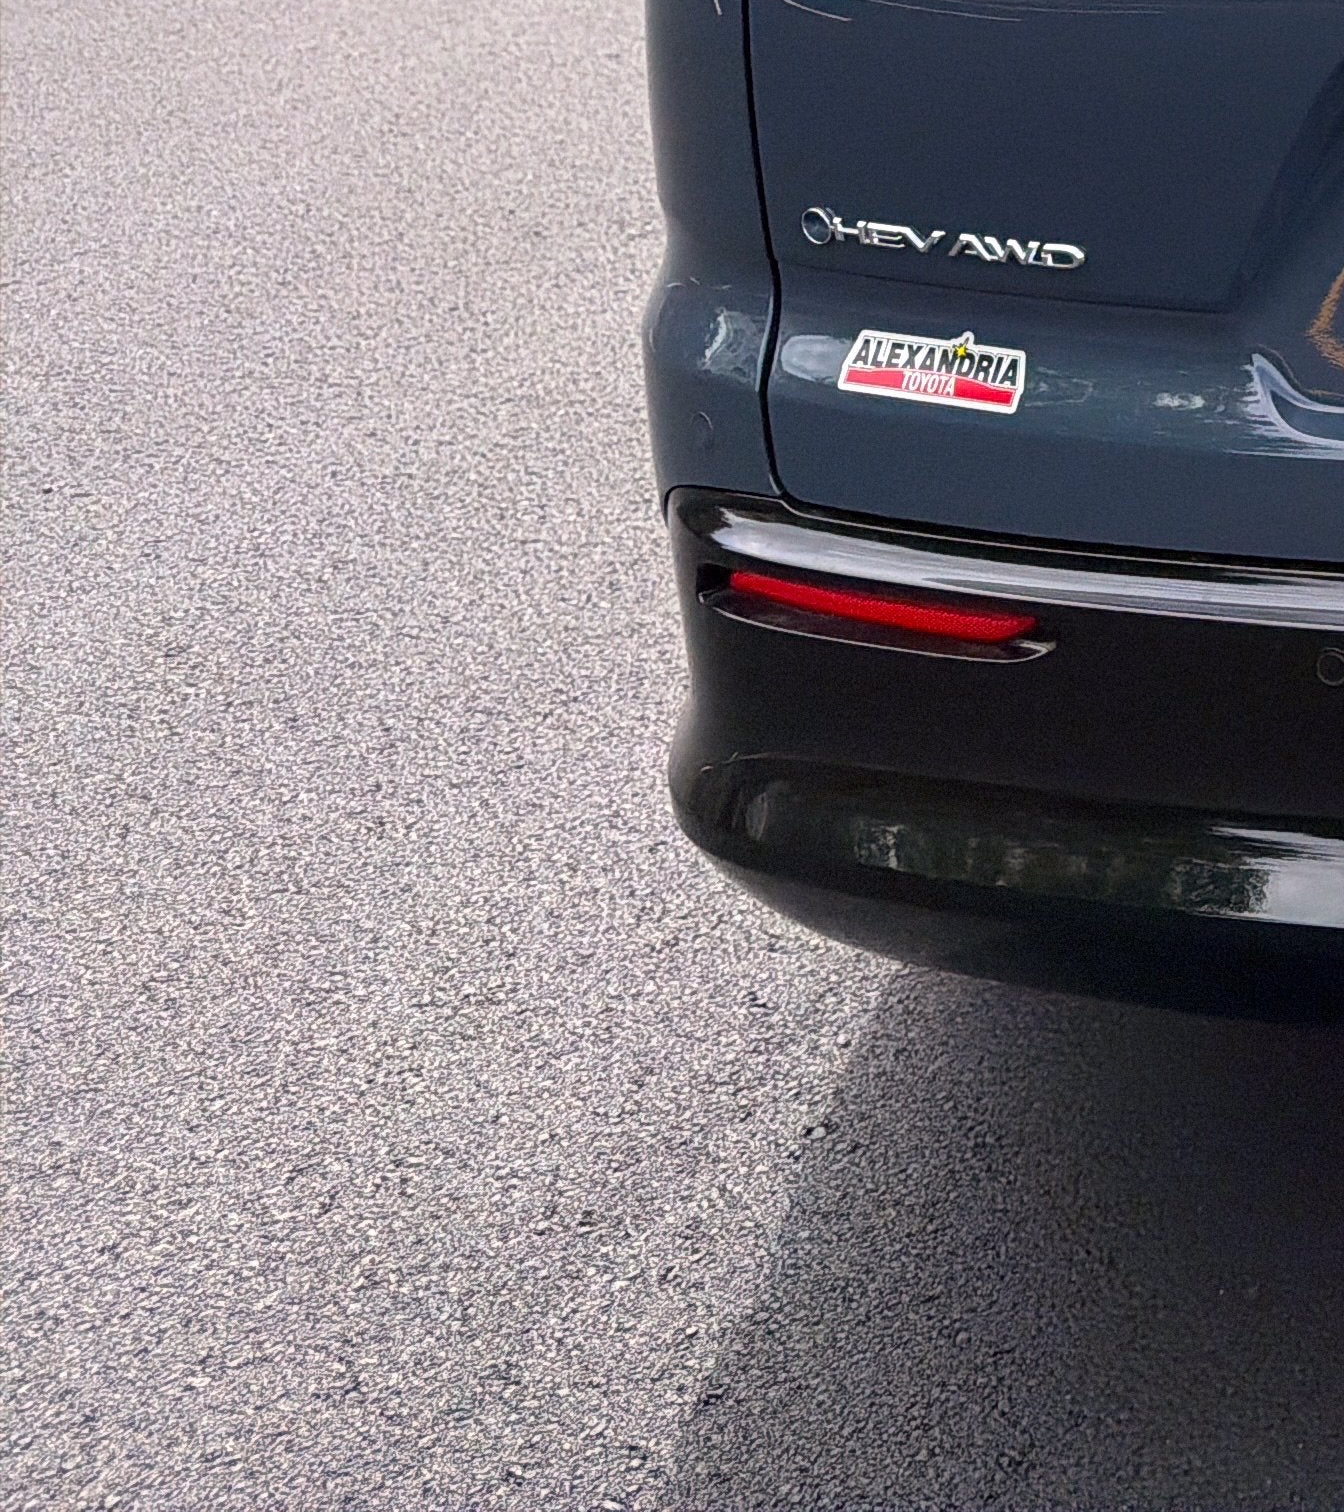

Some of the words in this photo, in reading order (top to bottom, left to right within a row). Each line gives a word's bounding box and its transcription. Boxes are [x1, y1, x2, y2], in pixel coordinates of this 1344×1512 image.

[948, 233, 1087, 270] AWD
[851, 337, 1020, 388] ALEXANDRIA
[901, 370, 956, 397] TOYOTA
